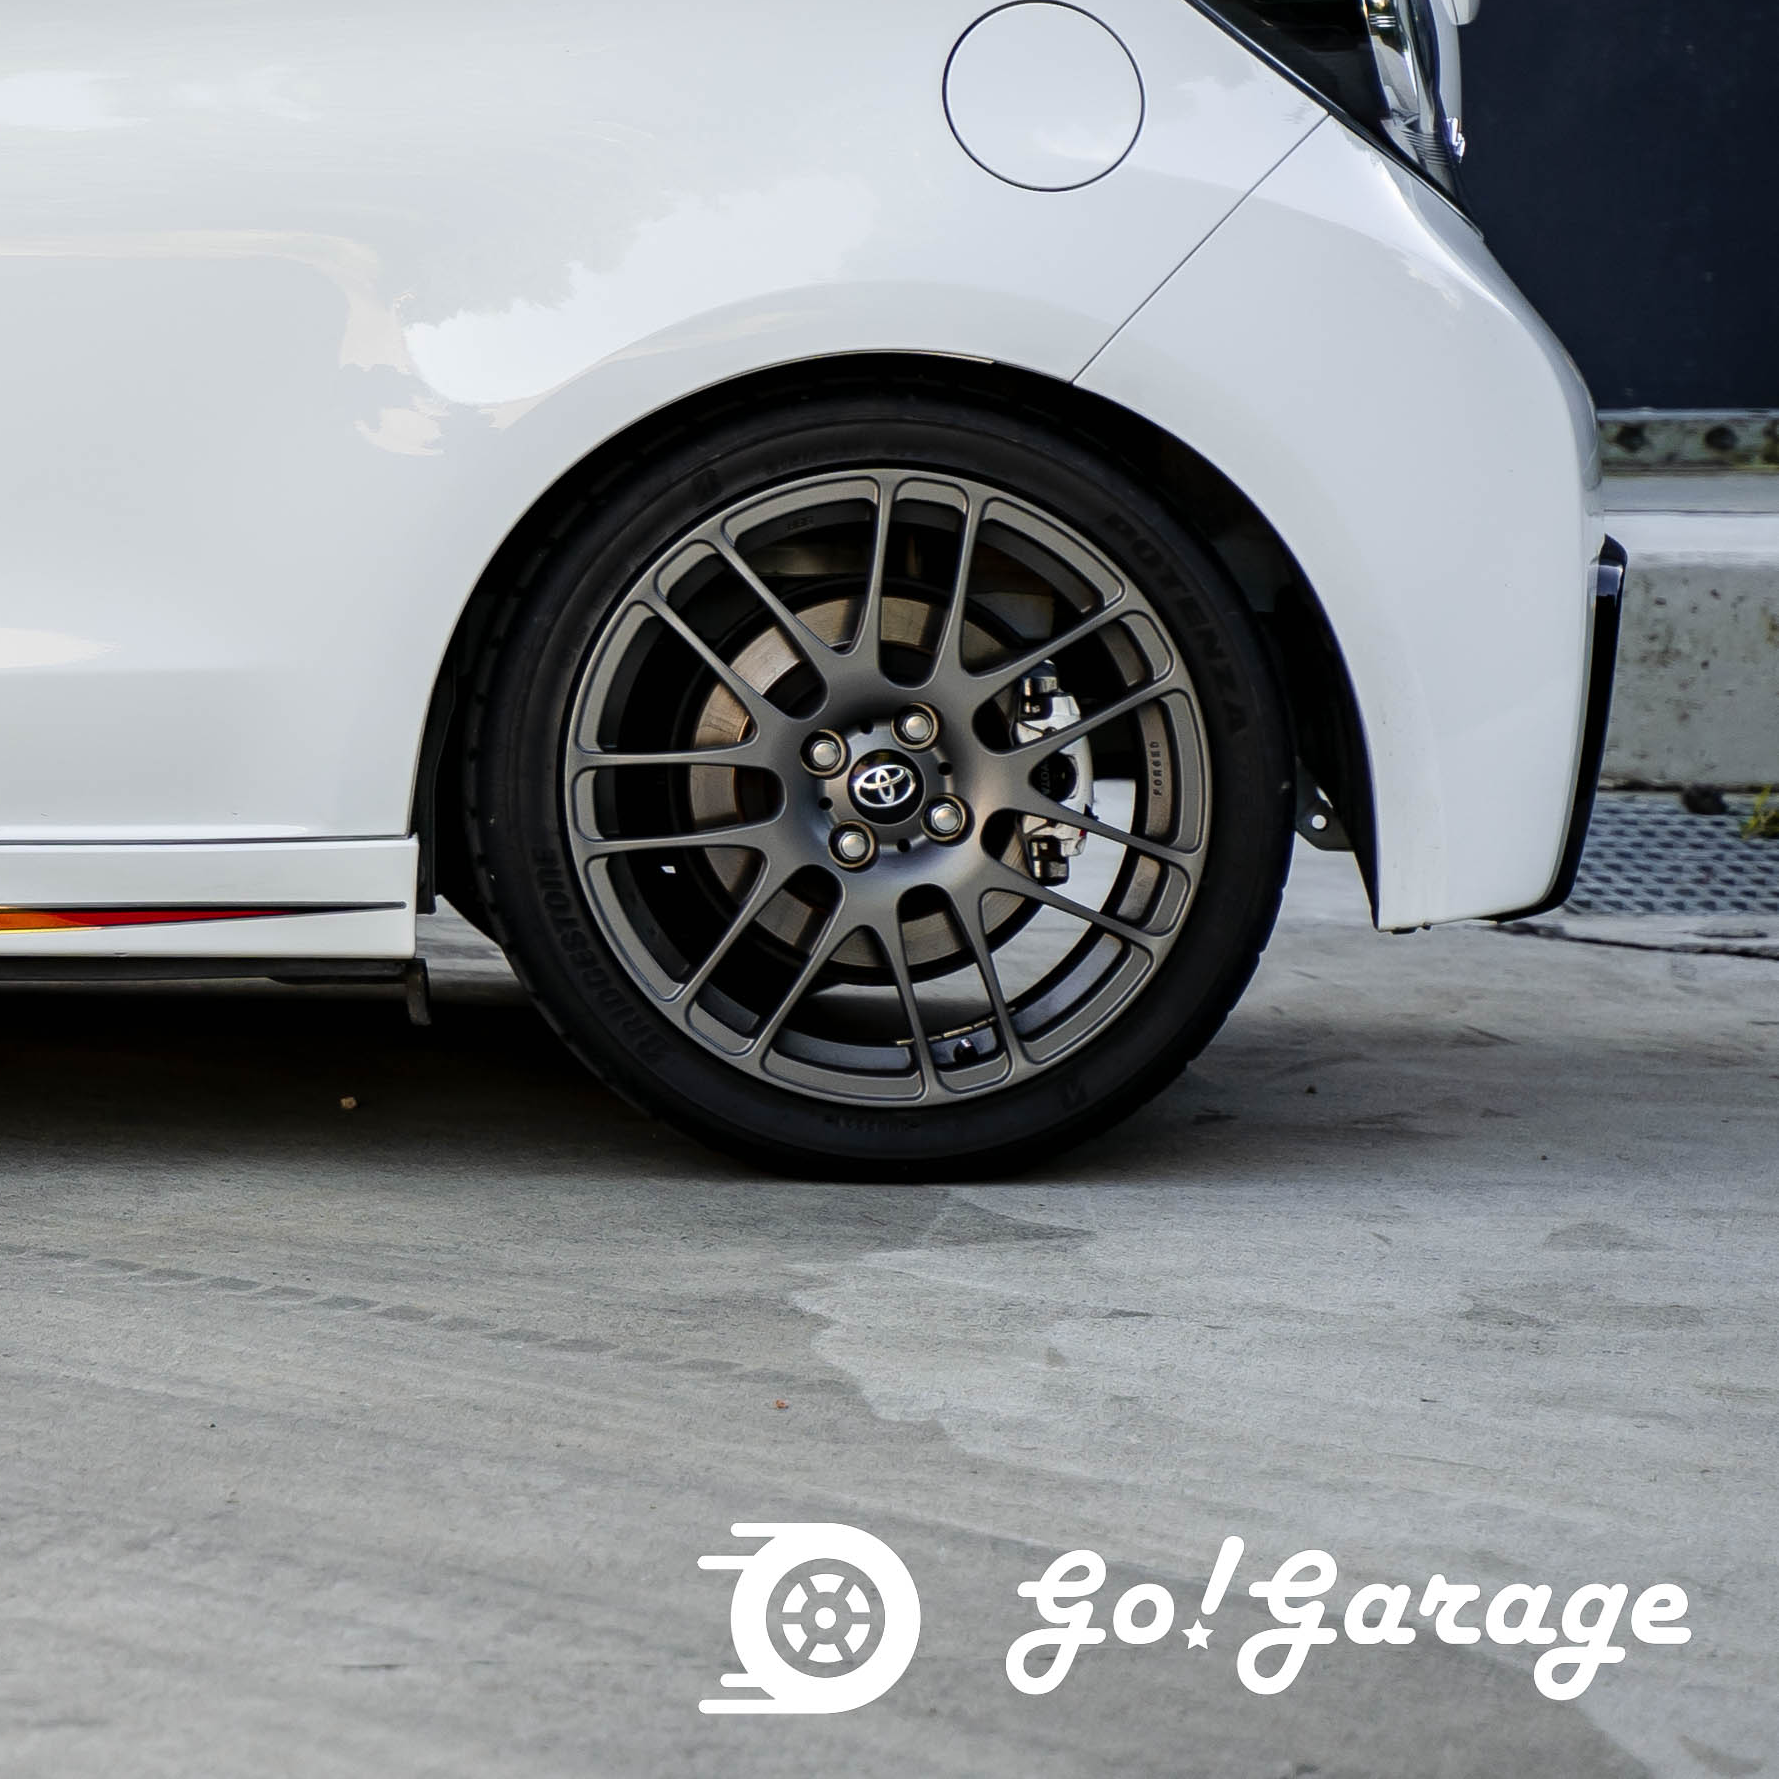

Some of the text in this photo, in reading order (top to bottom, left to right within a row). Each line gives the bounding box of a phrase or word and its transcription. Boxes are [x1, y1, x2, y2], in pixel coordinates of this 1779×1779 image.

[1102, 512, 1249, 737] POTENZA
[1149, 740, 1163, 797] FORGED
[533, 845, 675, 1075] BRIDGESTONE
